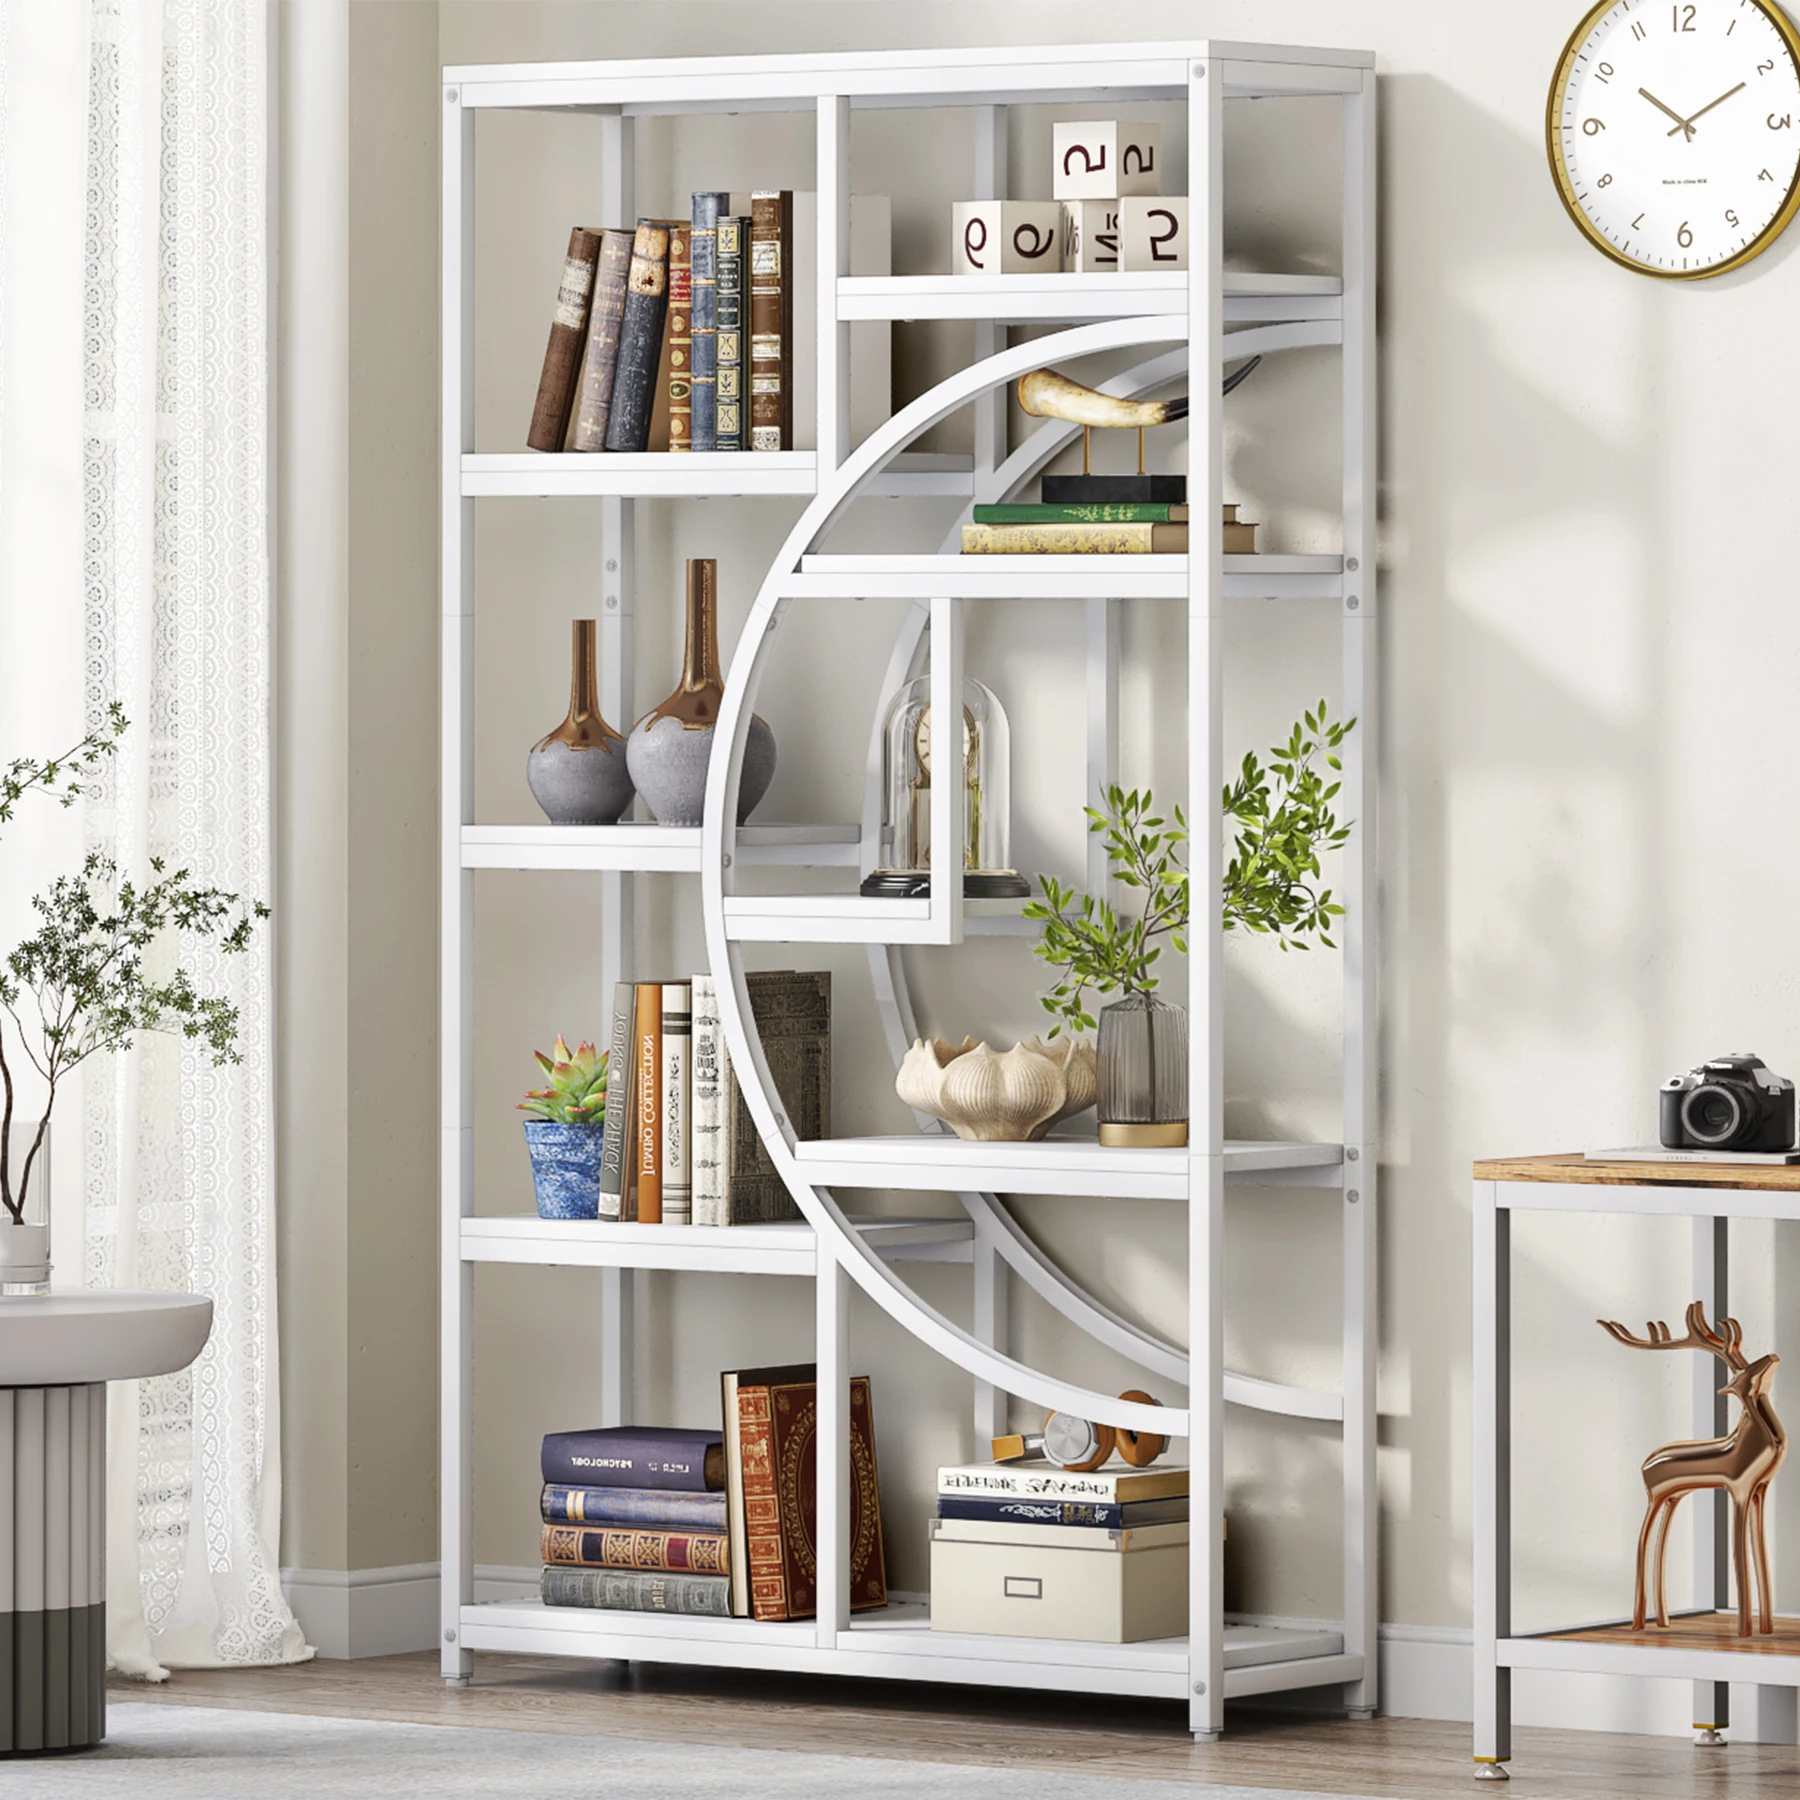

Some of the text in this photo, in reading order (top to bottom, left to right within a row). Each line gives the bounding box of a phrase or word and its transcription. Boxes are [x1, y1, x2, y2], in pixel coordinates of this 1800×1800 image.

[1673, 5, 1697, 33] 12
[1726, 19, 1737, 37] 1
[1630, 20, 1647, 42] 11
[1594, 61, 1615, 85] 10
[1756, 59, 1775, 77] 2
[1582, 117, 1607, 137] 9
[1766, 113, 1791, 131] 3
[1596, 173, 1613, 189] 8
[1757, 168, 1774, 182] 4
[1630, 212, 1646, 231] 7
[1725, 208, 1740, 229] 5
[1676, 220, 1694, 249] 6
